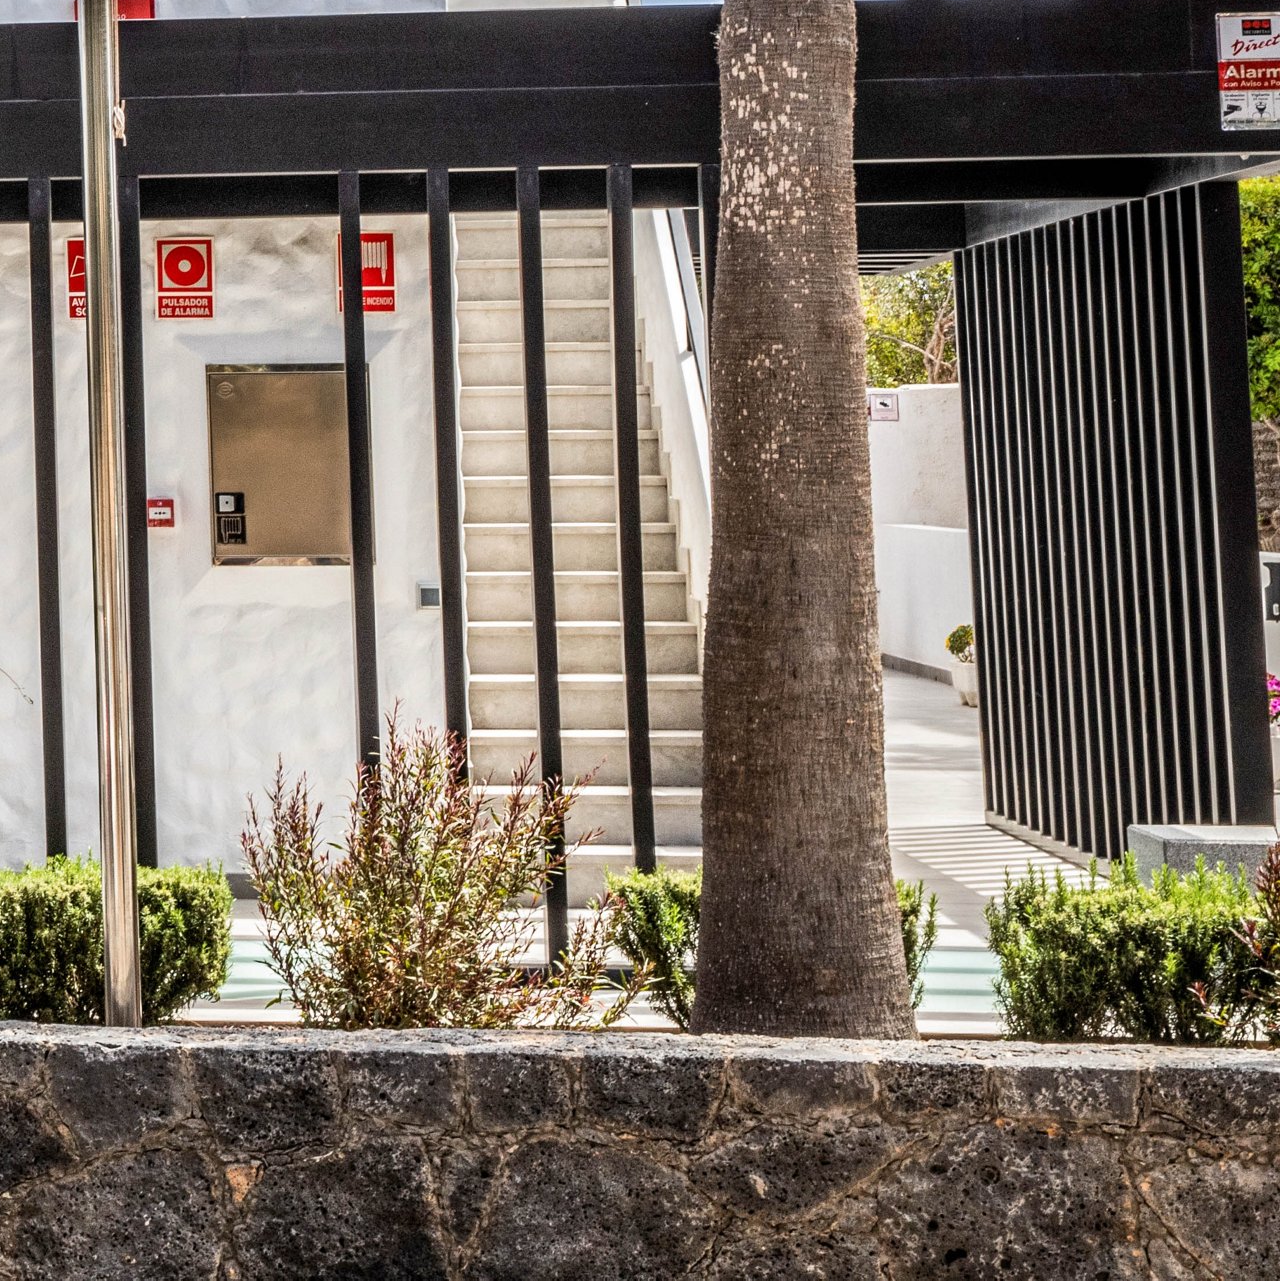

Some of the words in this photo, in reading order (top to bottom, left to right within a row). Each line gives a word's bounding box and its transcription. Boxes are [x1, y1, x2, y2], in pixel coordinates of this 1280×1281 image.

[162, 298, 208, 307] PULSADOR
[366, 297, 394, 306] INCENDIO
[160, 308, 172, 316] DE
[174, 307, 210, 316] ALARMA
